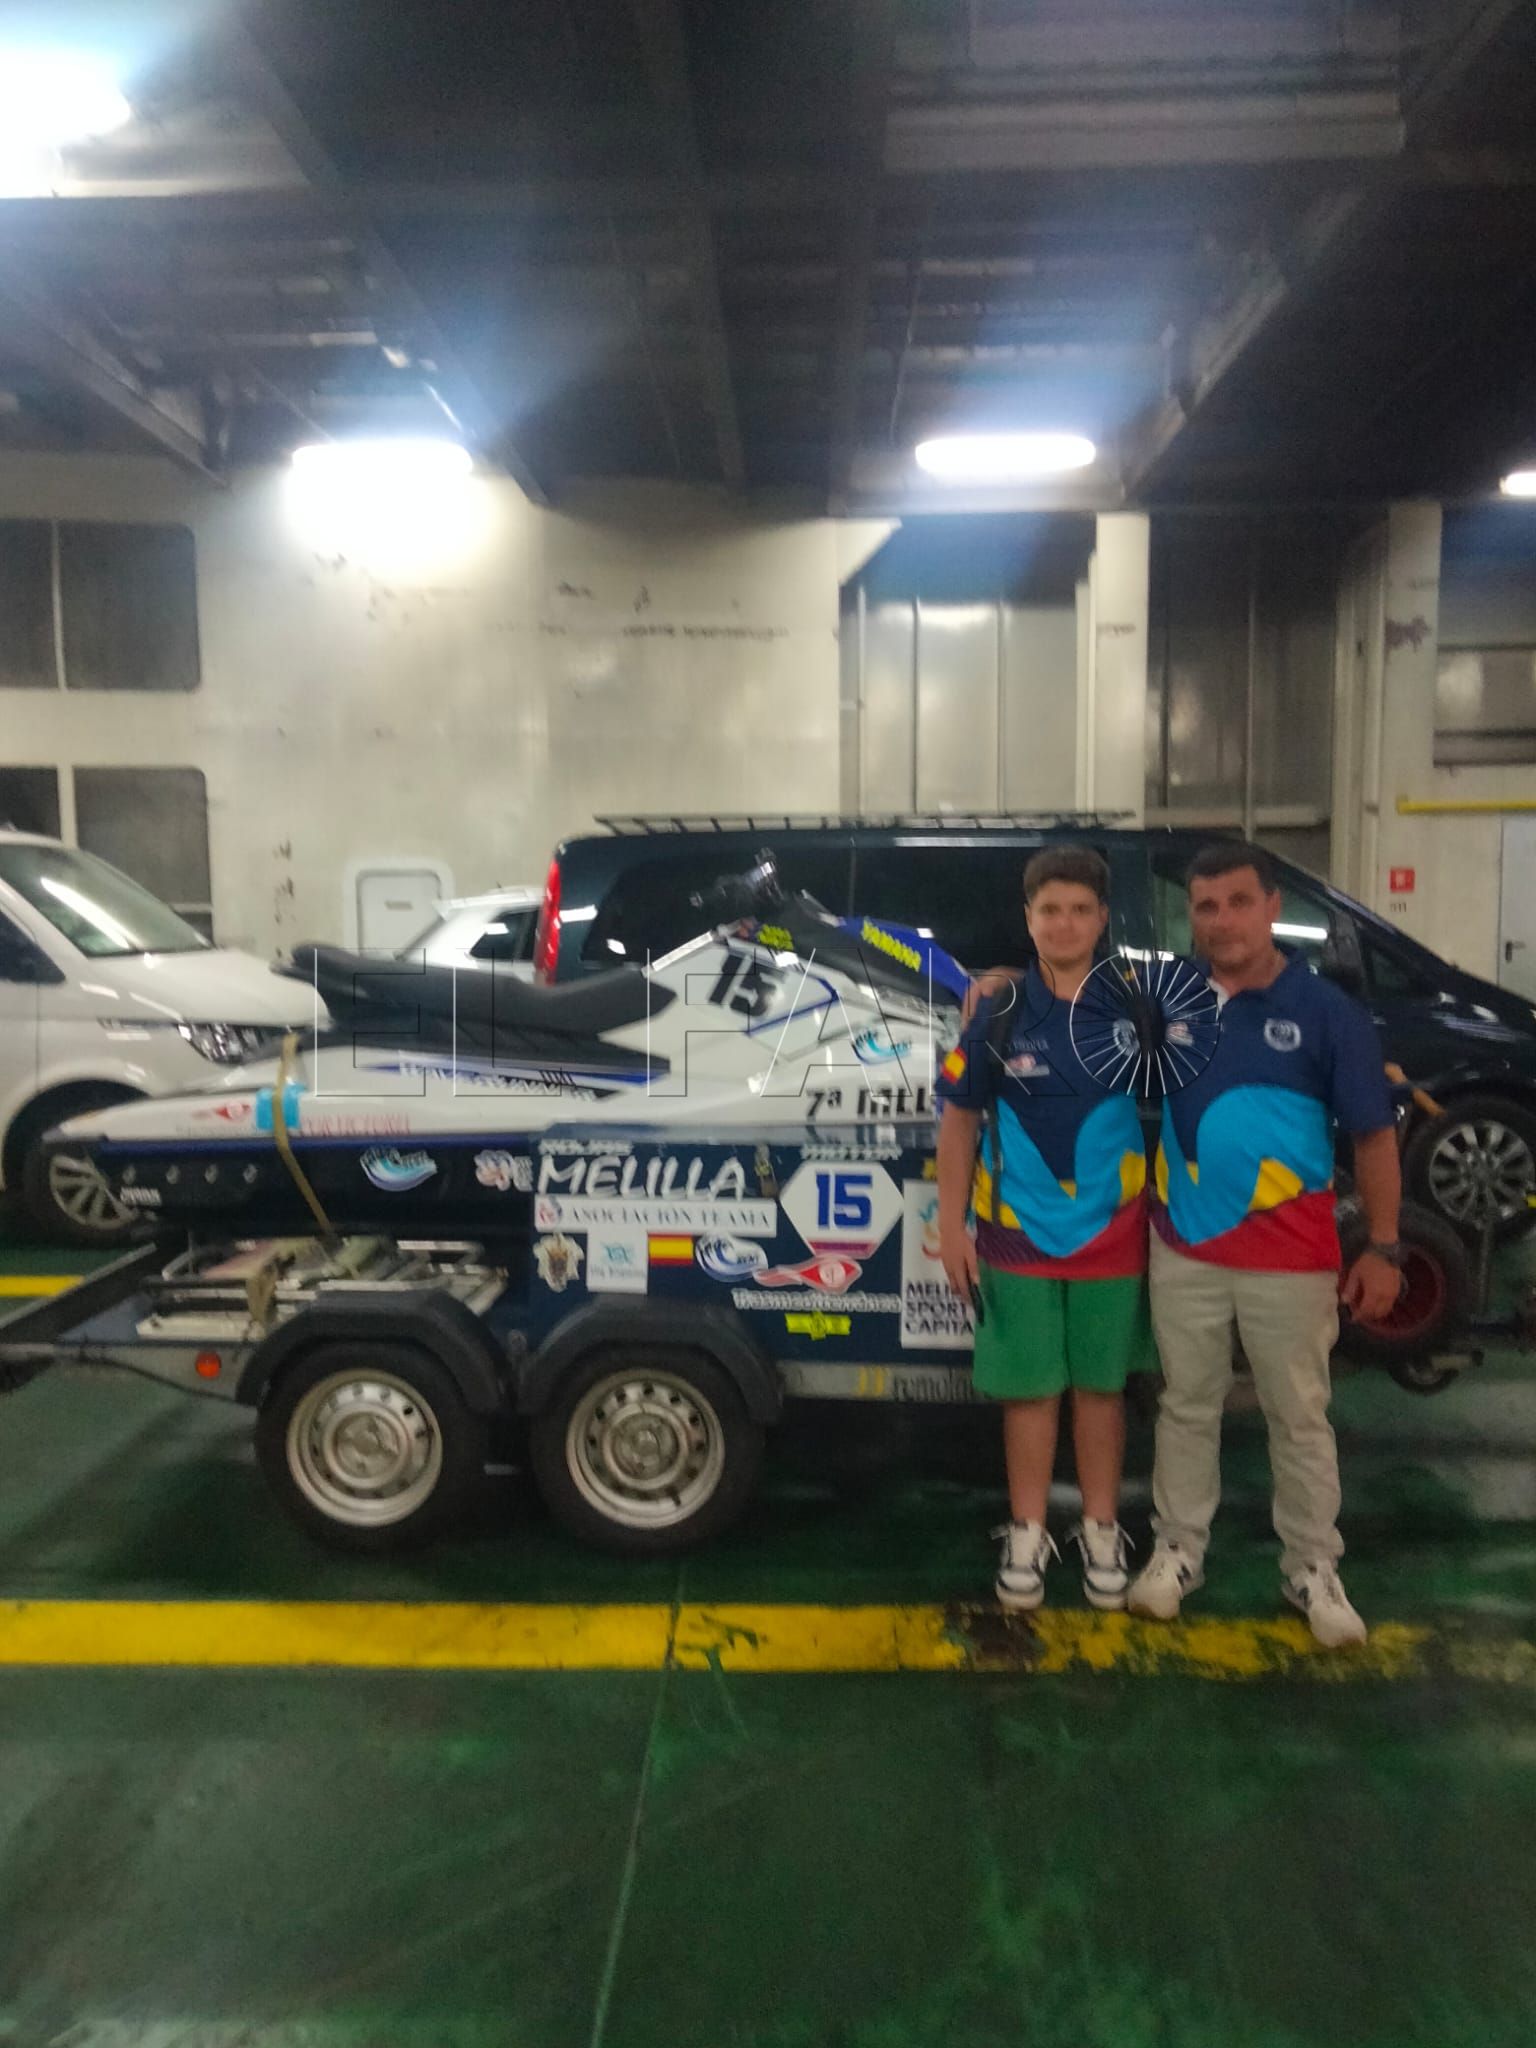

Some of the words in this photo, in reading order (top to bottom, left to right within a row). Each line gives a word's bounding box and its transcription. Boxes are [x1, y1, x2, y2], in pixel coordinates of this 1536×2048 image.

[708, 952, 787, 1017] 15
[538, 1154, 747, 1200] MELILLA
[816, 1173, 872, 1228] 15
[905, 1320, 976, 1336] CAPITA
